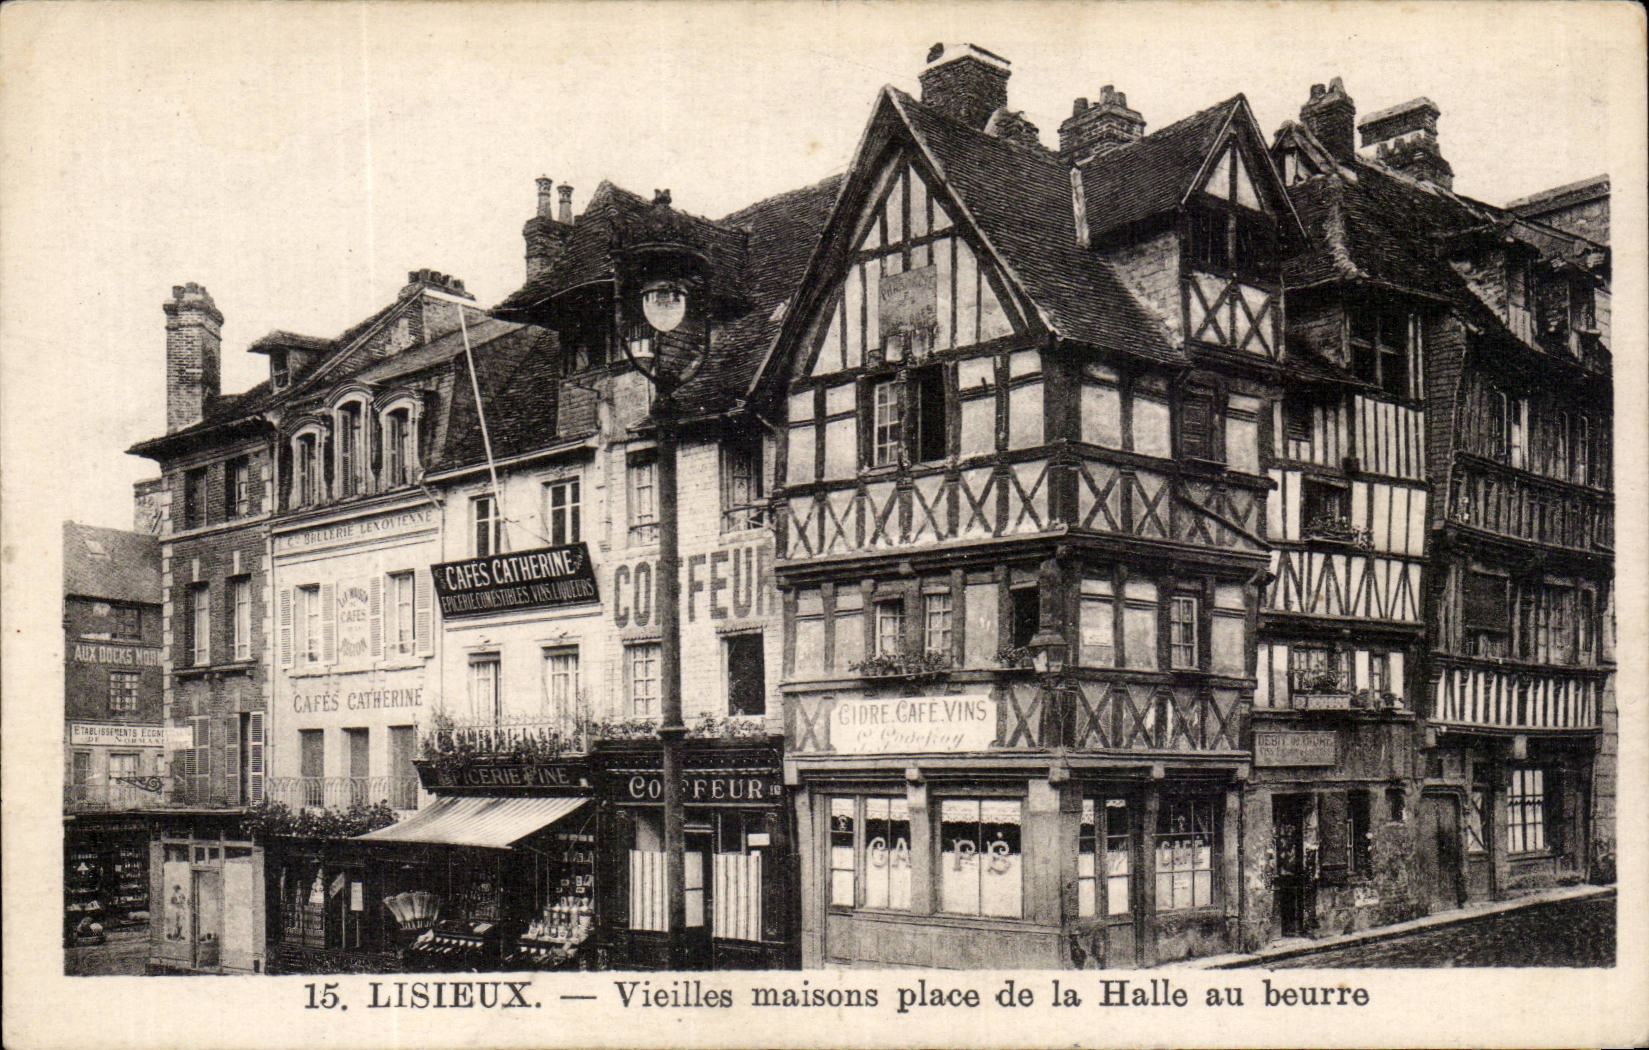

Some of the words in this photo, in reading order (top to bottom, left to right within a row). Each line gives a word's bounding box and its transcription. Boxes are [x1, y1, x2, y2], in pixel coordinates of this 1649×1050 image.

[445, 560, 491, 592] CAFÉS
[491, 550, 576, 585] CATHERINE
[74, 644, 97, 662] AUX
[98, 646, 133, 665] DOCKS
[293, 691, 340, 713] CAFÉS
[347, 687, 424, 711] CATHERINE
[943, 699, 987, 722] VINS
[438, 767, 522, 787] PICERIE
